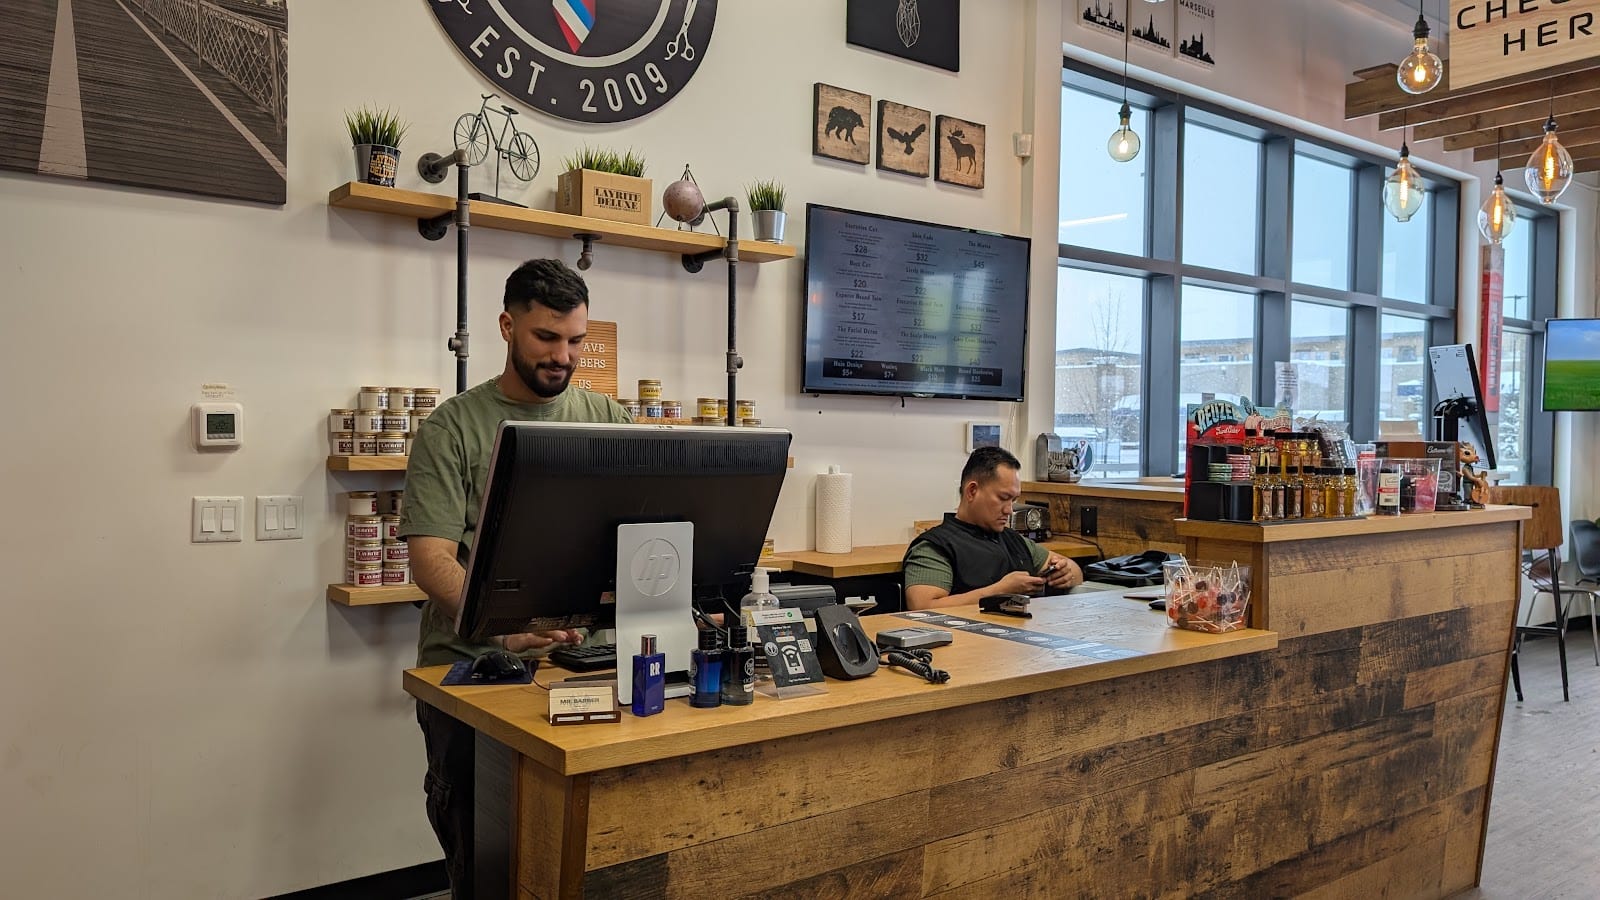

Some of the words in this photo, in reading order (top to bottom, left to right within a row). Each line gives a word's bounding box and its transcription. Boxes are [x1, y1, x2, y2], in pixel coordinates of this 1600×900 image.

[1180, 0, 1215, 18] MARSEILLE
[1503, 12, 1593, 56] HER
[469, 25, 557, 105] EST.
[579, 62, 668, 113] 2009
[595, 188, 641, 202] LAYRITE
[597, 197, 638, 210] DELUXE
[854, 244, 868, 254] $28
[916, 252, 929, 262] $32
[973, 260, 985, 269] $45
[853, 279, 867, 288] $20
[852, 311, 866, 321] $17
[583, 343, 605, 353] AVE
[850, 349, 864, 359] $22
[576, 357, 606, 368] BERS
[578, 379, 592, 390] US
